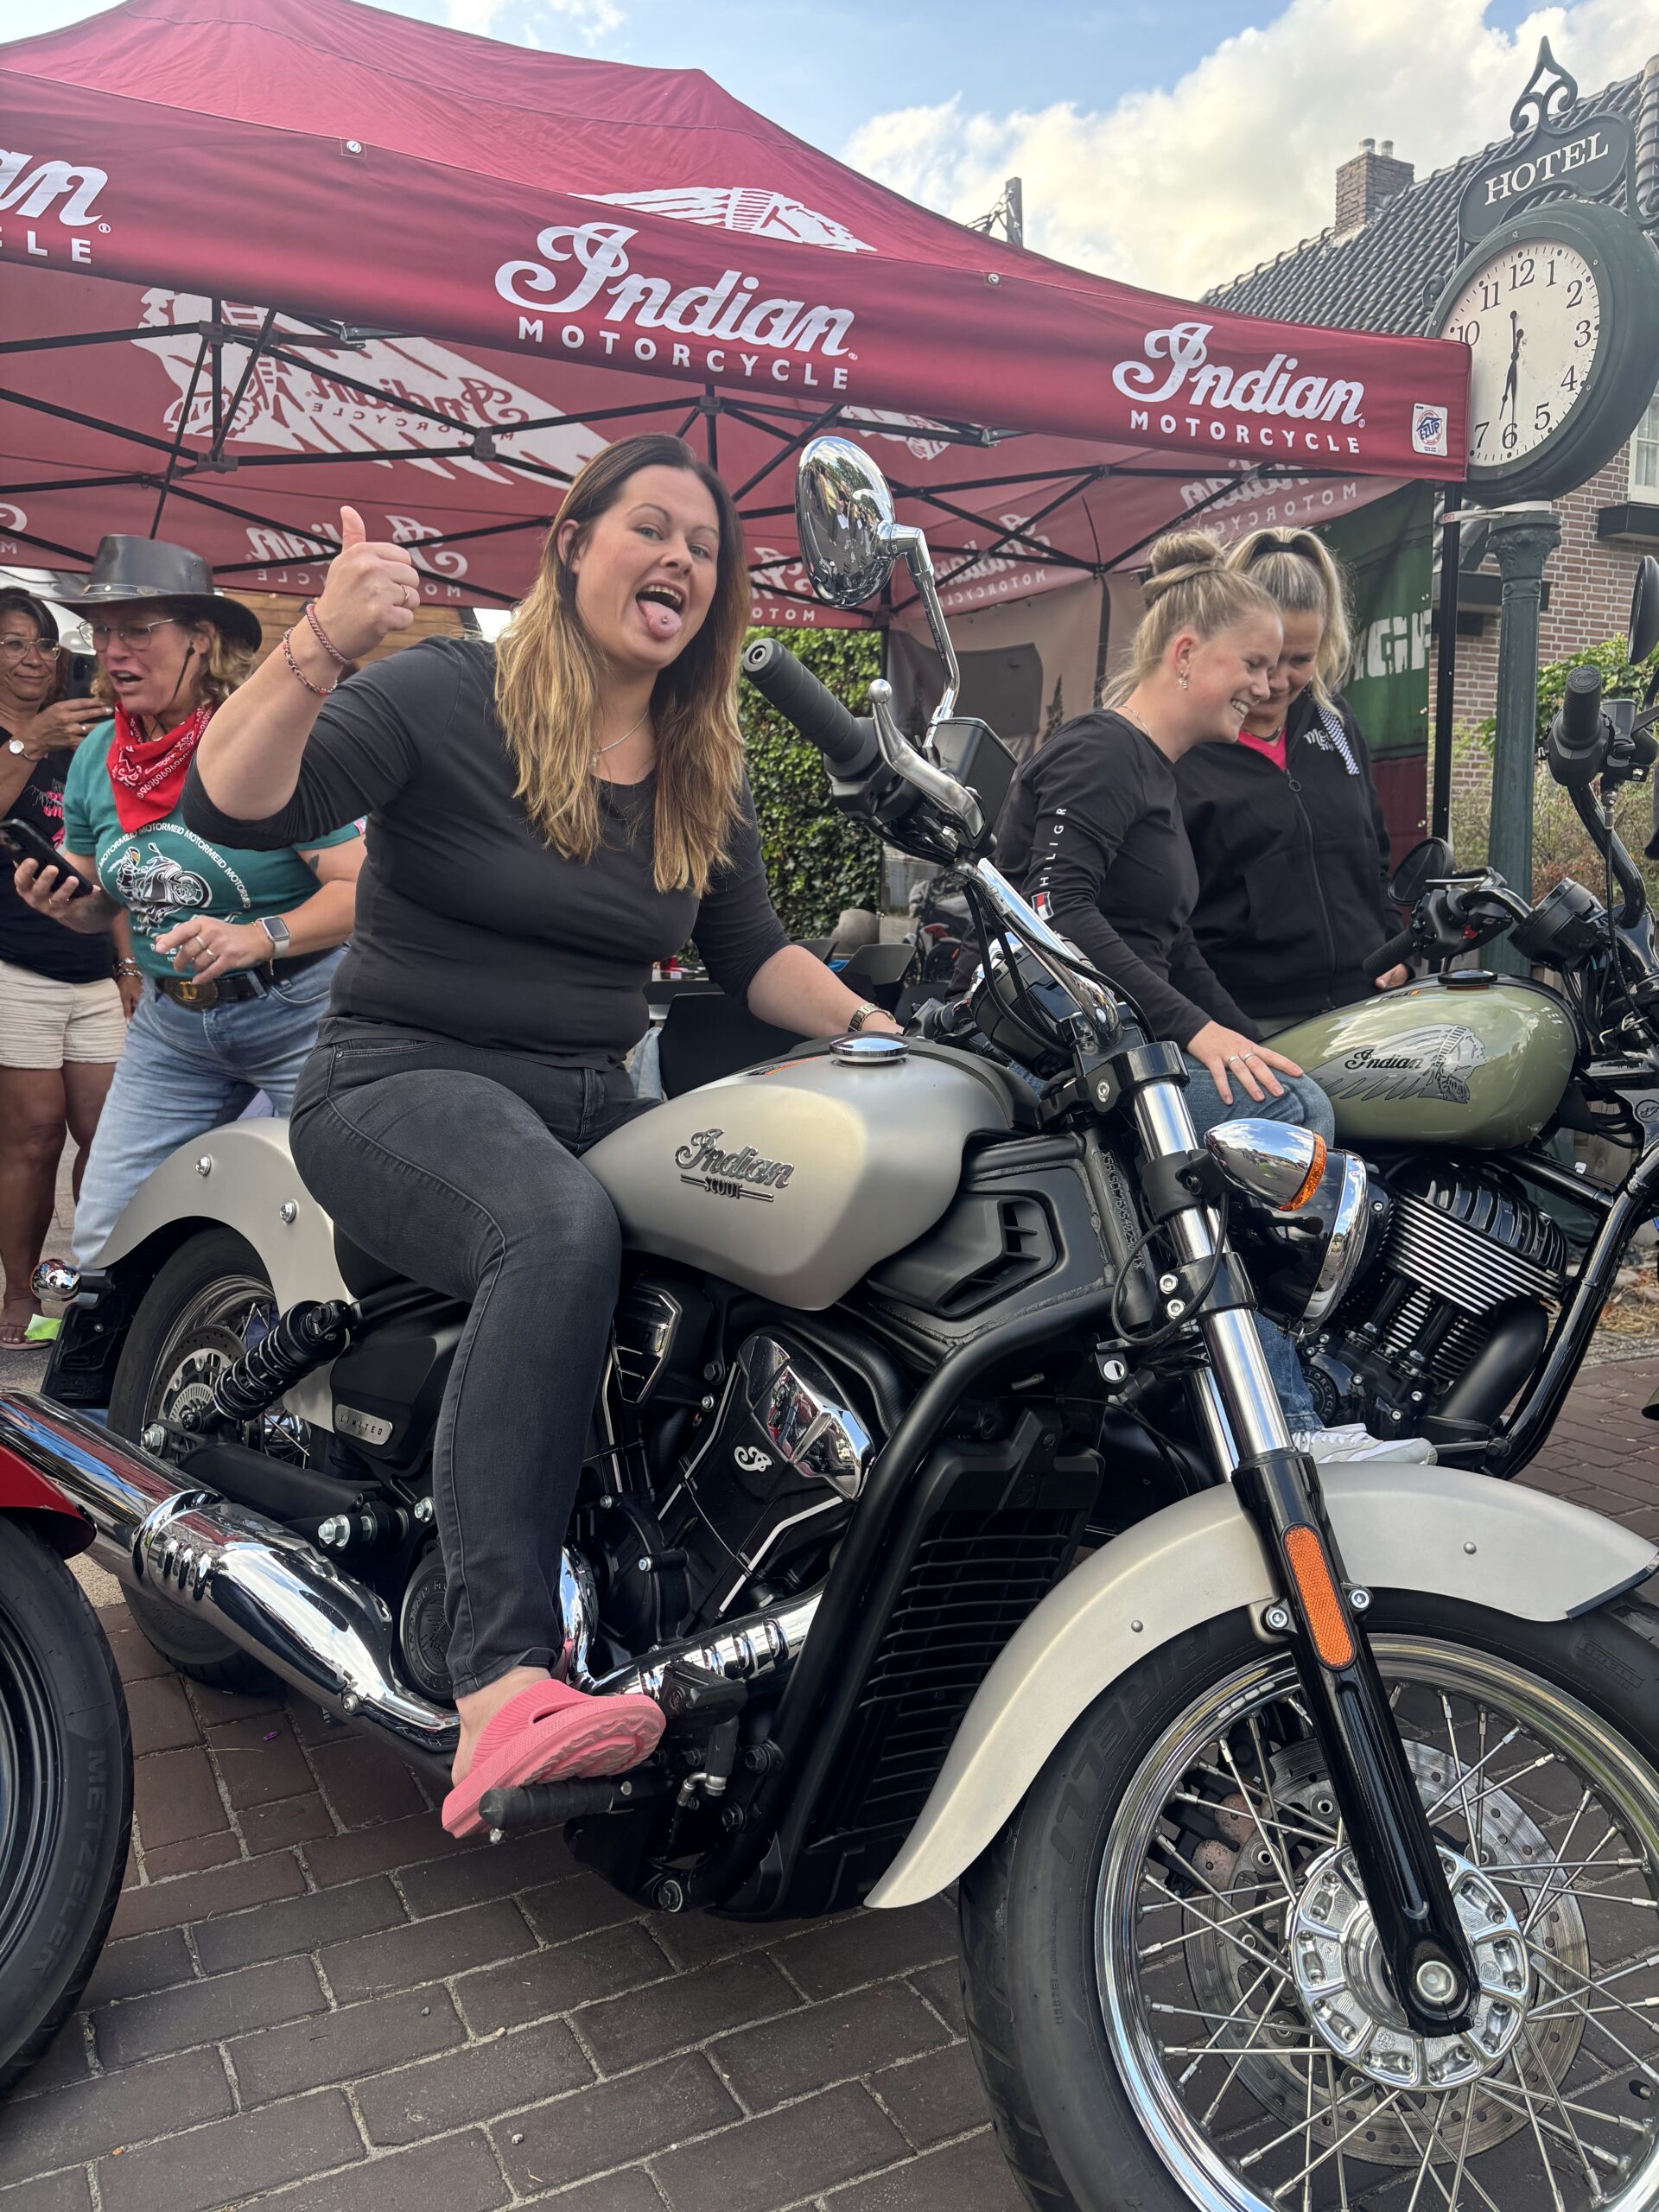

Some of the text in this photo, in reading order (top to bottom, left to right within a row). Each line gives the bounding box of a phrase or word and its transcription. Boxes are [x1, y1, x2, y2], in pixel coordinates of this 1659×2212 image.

[1484, 132, 1609, 206] HOTEL
[495, 222, 855, 357] Indian
[1509, 258, 1558, 292] 12 1
[1480, 280, 1502, 312] 11
[1566, 279, 1583, 309] 2
[1456, 320, 1480, 347] 10
[1574, 320, 1592, 348] 3
[518, 315, 849, 391] MOTORCYCLE
[1112, 321, 1363, 422] Indian
[1560, 365, 1578, 392] 4
[1129, 410, 1361, 454] MOTORCYCLE
[1534, 402, 1550, 431] 5
[1474, 422, 1518, 449] 7 6
[184, 829, 227, 868] MOTORMEID
[1344, 1048, 1424, 1071] Indian
[675, 1128, 794, 1189] Indian
[704, 1175, 743, 1199] SCOUT
[340, 1414, 383, 1436] LIMITED
[30, 1749, 110, 1980] METZELER
